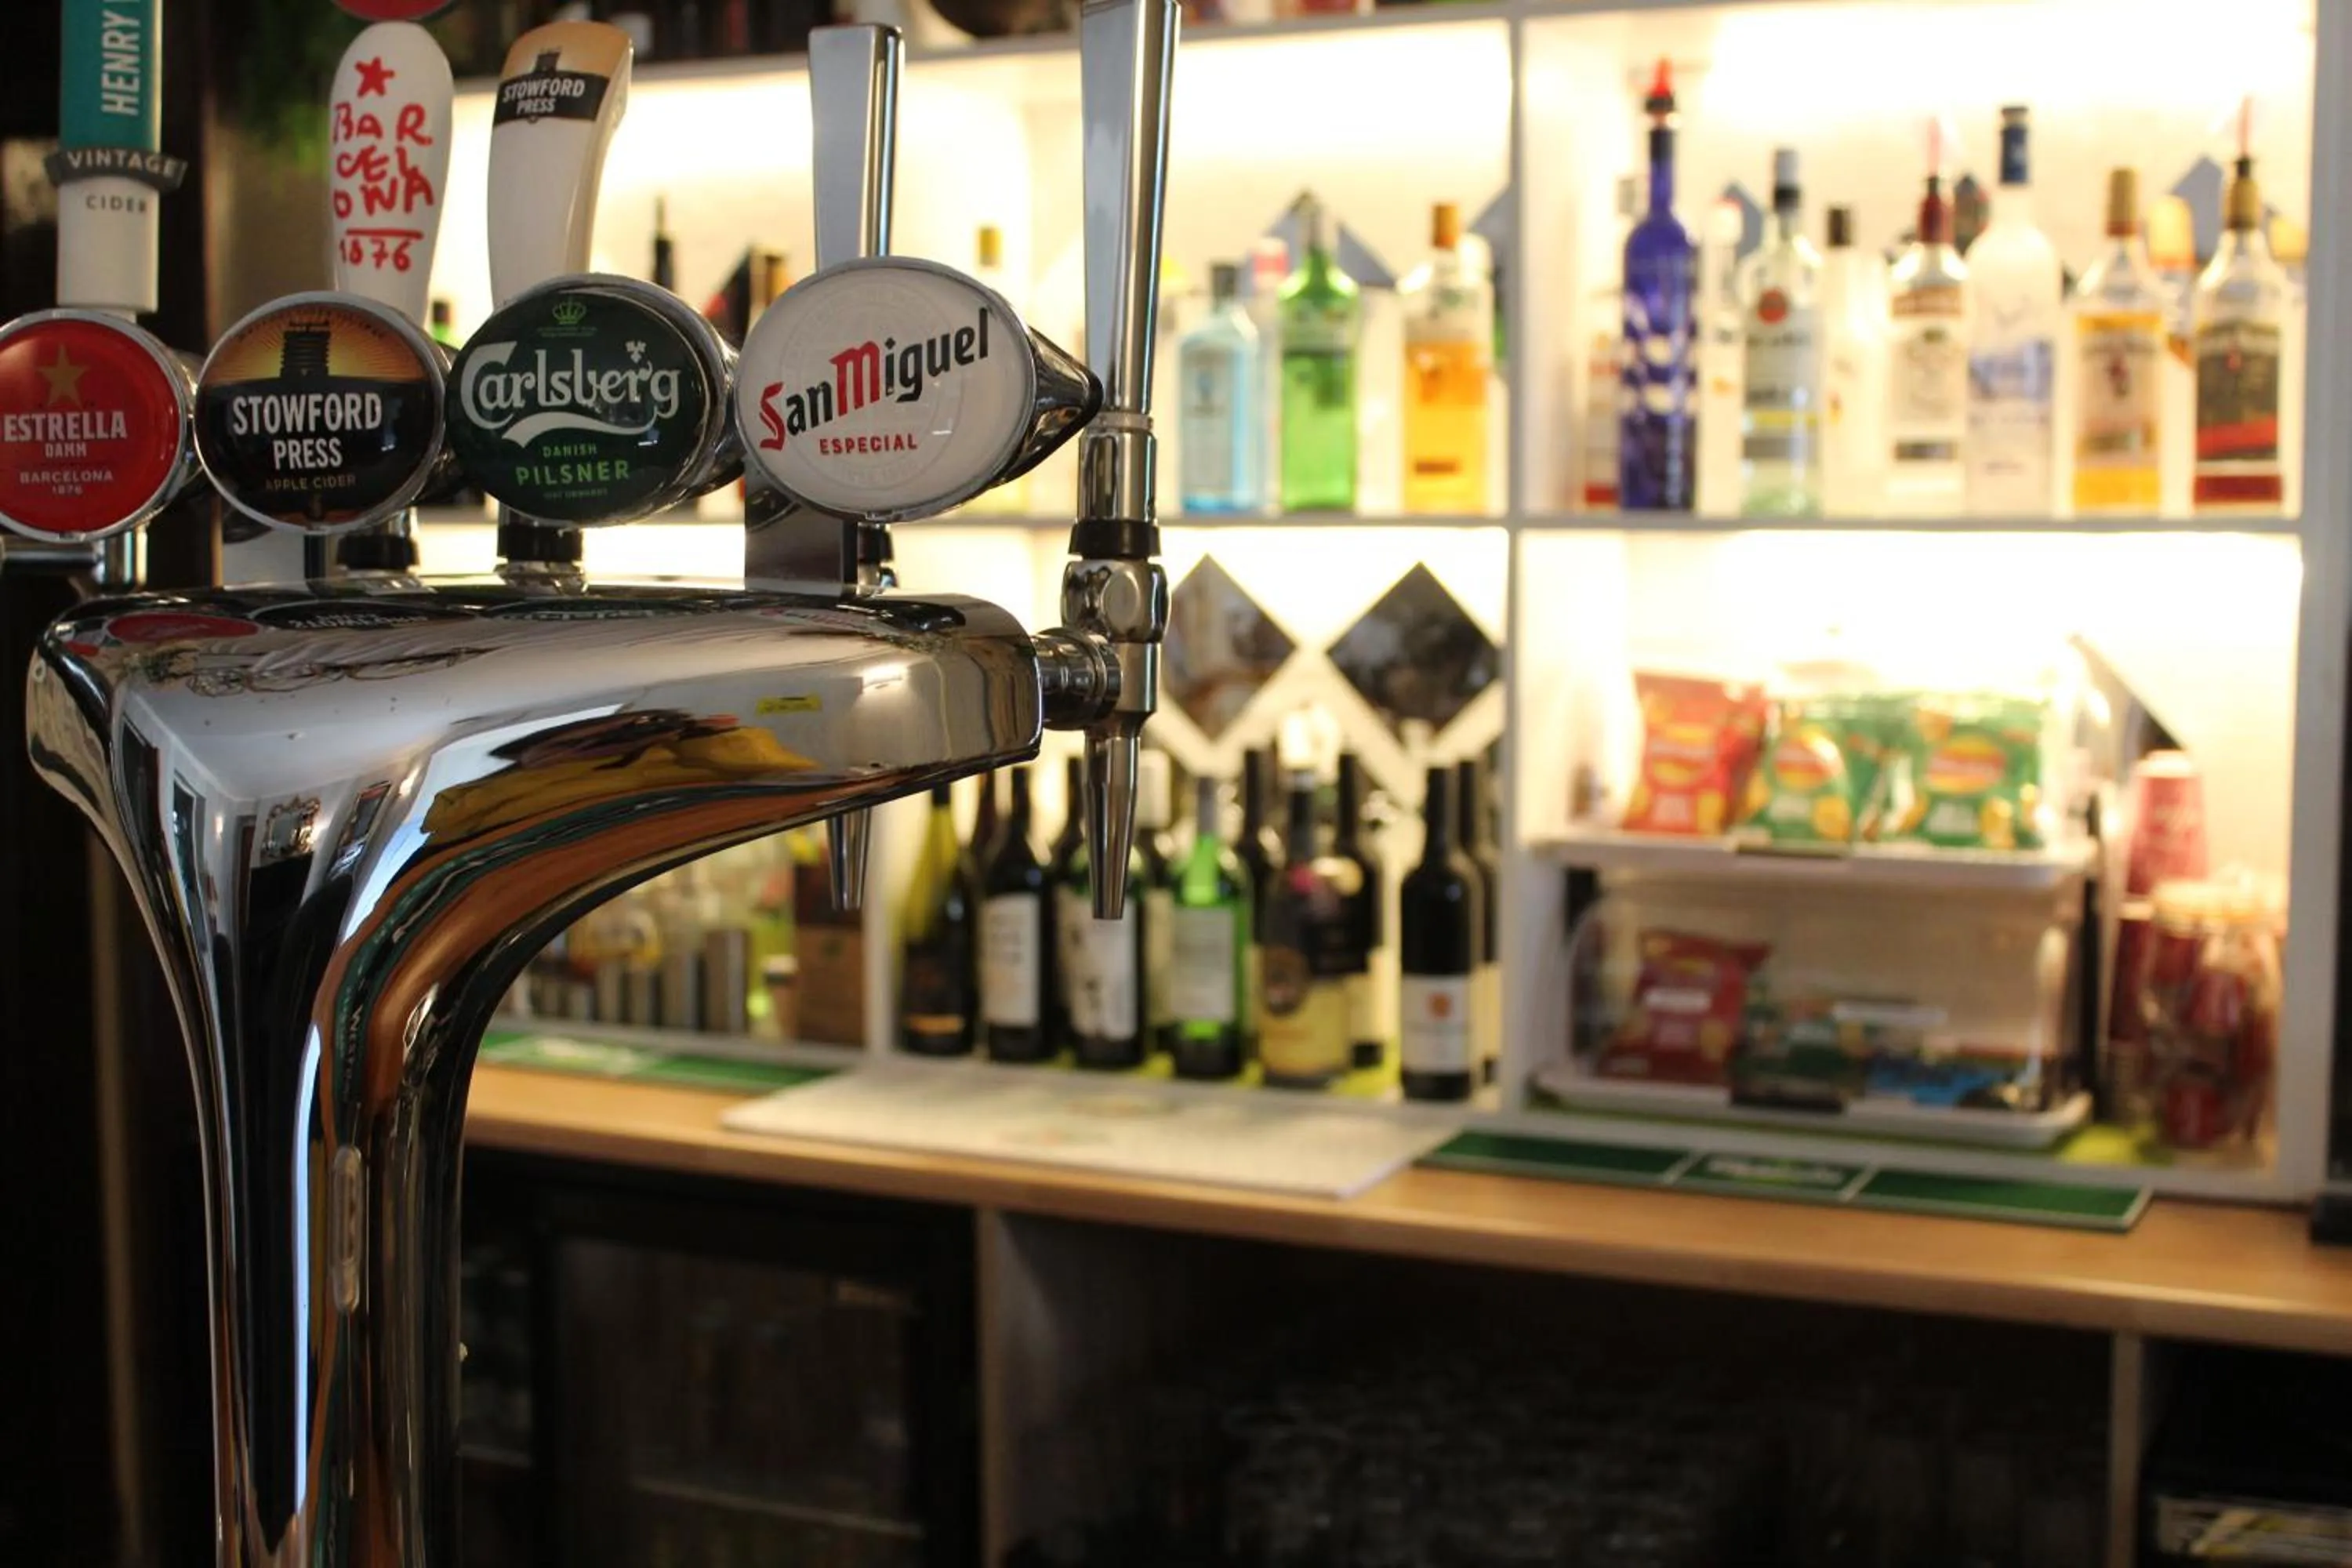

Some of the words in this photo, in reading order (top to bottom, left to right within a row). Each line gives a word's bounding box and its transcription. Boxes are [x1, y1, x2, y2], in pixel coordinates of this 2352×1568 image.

[101, 9, 140, 115] HENRY
[502, 78, 586, 103] STOWFORD
[516, 98, 557, 114] PRESS
[67, 147, 176, 178] VINTAGE
[85, 195, 147, 212] CIDER
[339, 238, 411, 272] 1876
[460, 340, 681, 430] Carlsberg
[4, 411, 128, 442] ESTRELLA
[233, 393, 383, 436] STOWFORD
[45, 442, 87, 458] DAMM
[273, 437, 343, 470] PRESS
[543, 444, 597, 458] DANISH
[818, 434, 918, 455] ESPECIAL
[20, 470, 114, 484] BARCELONA
[266, 477, 308, 492] APPLE
[312, 473, 356, 489] CIDER
[515, 459, 630, 486] PILSNER
[52, 485, 83, 495] 1876
